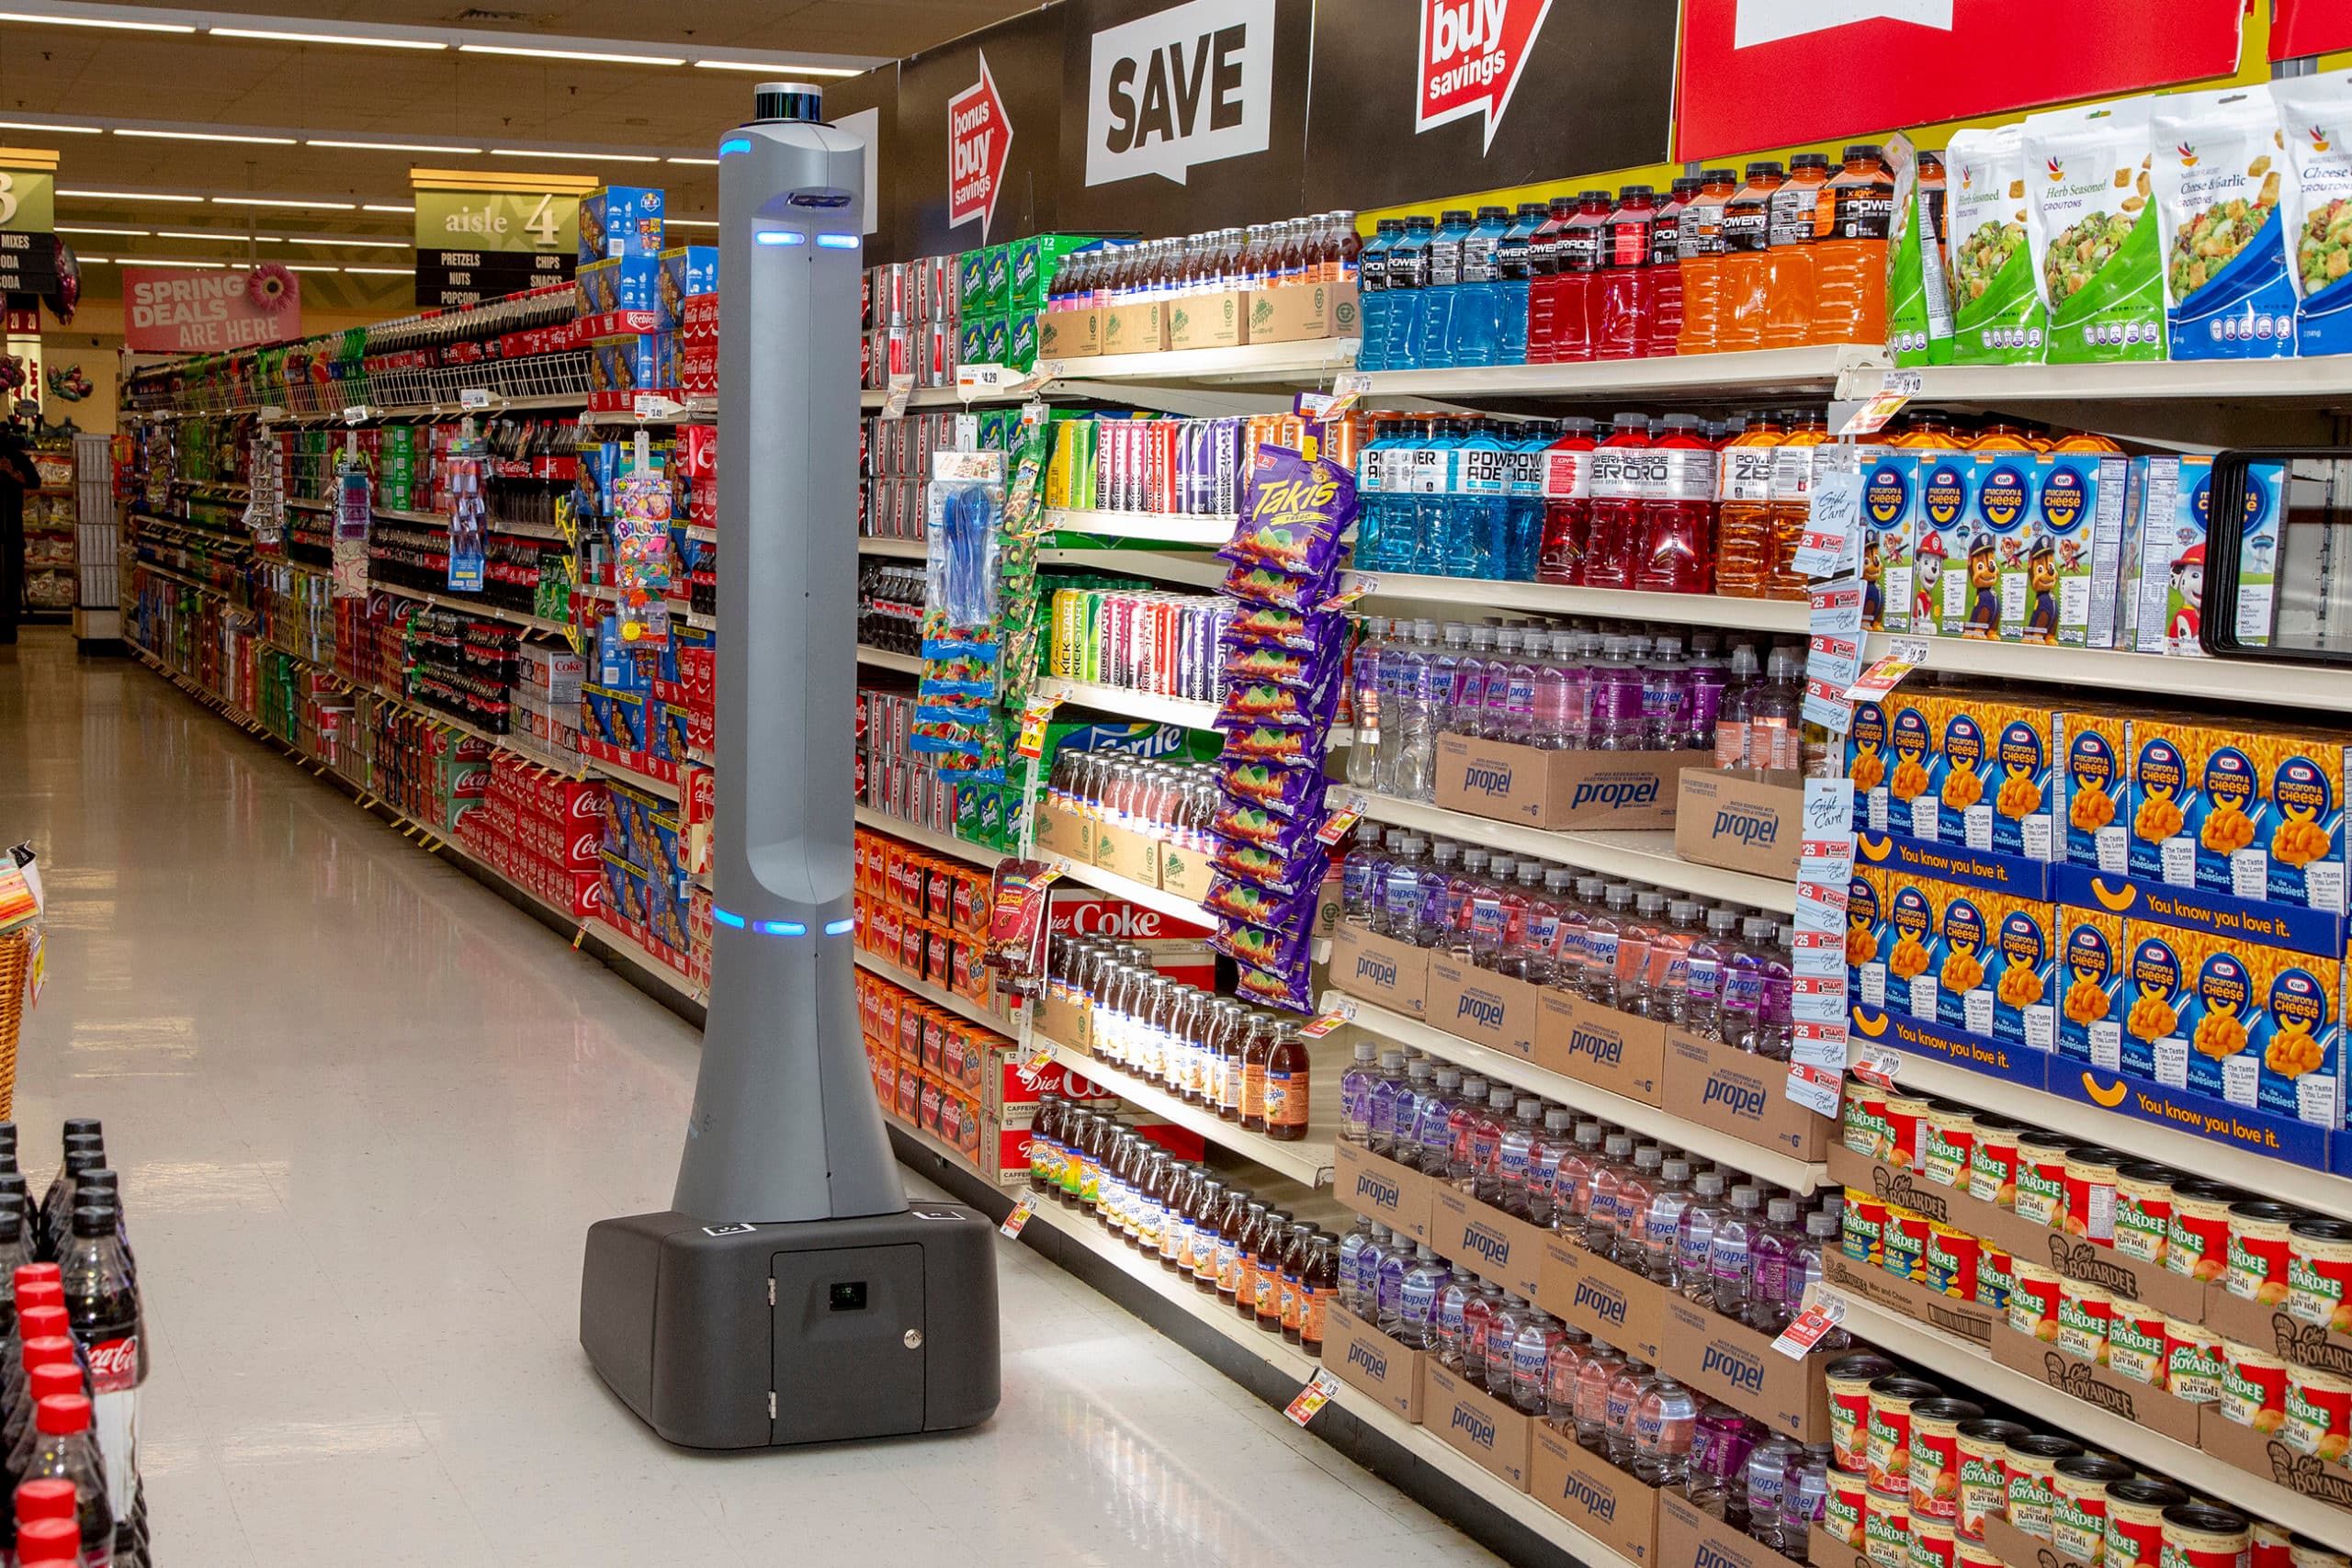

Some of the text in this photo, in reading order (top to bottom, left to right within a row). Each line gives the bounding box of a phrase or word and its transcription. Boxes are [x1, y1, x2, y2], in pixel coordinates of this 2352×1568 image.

[1430, 0, 1509, 65] buy
[1430, 50, 1506, 100] savings
[1105, 22, 1247, 154] SAVE
[954, 100, 989, 138] bonus
[956, 130, 991, 181] buy
[2303, 166, 2347, 180] Cheese
[956, 175, 991, 206] savings
[2045, 179, 2108, 199] Herb Seasoned
[2043, 199, 2083, 212] CROUTONS
[446, 193, 560, 245] aisle 4
[1, 234, 30, 250] MIXES
[441, 253, 481, 267] PRETZELS
[536, 255, 560, 269] CHIPS
[449, 272, 470, 286] NUTS
[530, 274, 562, 288] SNACKS
[133, 276, 245, 306] SPRING
[441, 290, 481, 306] POPCORN
[131, 299, 228, 329] DEALS
[179, 316, 281, 348] ARE HERE
[982, 372, 998, 384] $4.29
[1879, 475, 1893, 483] Kraft
[1996, 475, 2010, 484] Kraft
[1818, 491, 1847, 507] Gift
[1870, 488, 1896, 496] macaroni
[1984, 489, 2016, 497] macaroni
[1253, 481, 1340, 522] Takis
[1819, 504, 1848, 522] Card
[617, 519, 668, 538] BALLOONS
[554, 660, 582, 672] Coke
[2153, 750, 2167, 759] Kraft
[2142, 761, 2173, 774] macaroni
[2221, 759, 2238, 769] Kraft
[1464, 767, 1512, 795] propel
[2210, 771, 2243, 784] macaroni
[2292, 768, 2310, 779] Kraft
[1571, 777, 1659, 809] propel
[2278, 781, 2316, 794] macaroni
[1809, 795, 1837, 817] Gift
[1814, 807, 1844, 829] Card
[1713, 810, 1779, 845] propel
[1801, 842, 1815, 855] $25
[1829, 842, 1849, 853] GIANT
[1899, 845, 2008, 882] You know you love it.
[2267, 884, 2305, 898] cheesiest
[1051, 904, 1161, 937] iet Coke
[2146, 893, 2291, 938] You know you love it.
[1794, 934, 1809, 947] $25
[1824, 932, 1843, 943] GIANT
[1356, 956, 1396, 986] propel
[1792, 979, 1808, 992] $25
[1823, 979, 1843, 991] GIANT
[2289, 979, 2306, 990] Kraft
[2276, 991, 2312, 1006] macaroni
[1457, 995, 1505, 1027] propel
[1794, 1024, 1809, 1037] $25
[1826, 1024, 1846, 1037] GIANT
[1568, 1029, 1623, 1064] propel
[1896, 1023, 2010, 1069] You know you love it.
[1703, 1077, 1767, 1116] propel
[2258, 1091, 2296, 1109] cheesiest
[2137, 1092, 2280, 1149] You know you love it.
[1357, 1174, 1399, 1208] propel
[1463, 1226, 1510, 1265] propel
[2117, 1235, 2148, 1250] Ravioli
[1574, 1281, 1628, 1325] propel
[1347, 1342, 1388, 1380] propel
[1702, 1345, 1765, 1391] propel
[2180, 1384, 2220, 1397] Ravioli
[2189, 1378, 2208, 1387] Mini
[1452, 1404, 1496, 1449] propel
[1564, 1473, 1617, 1521] propel
[1970, 1493, 2005, 1506] Ravioli
